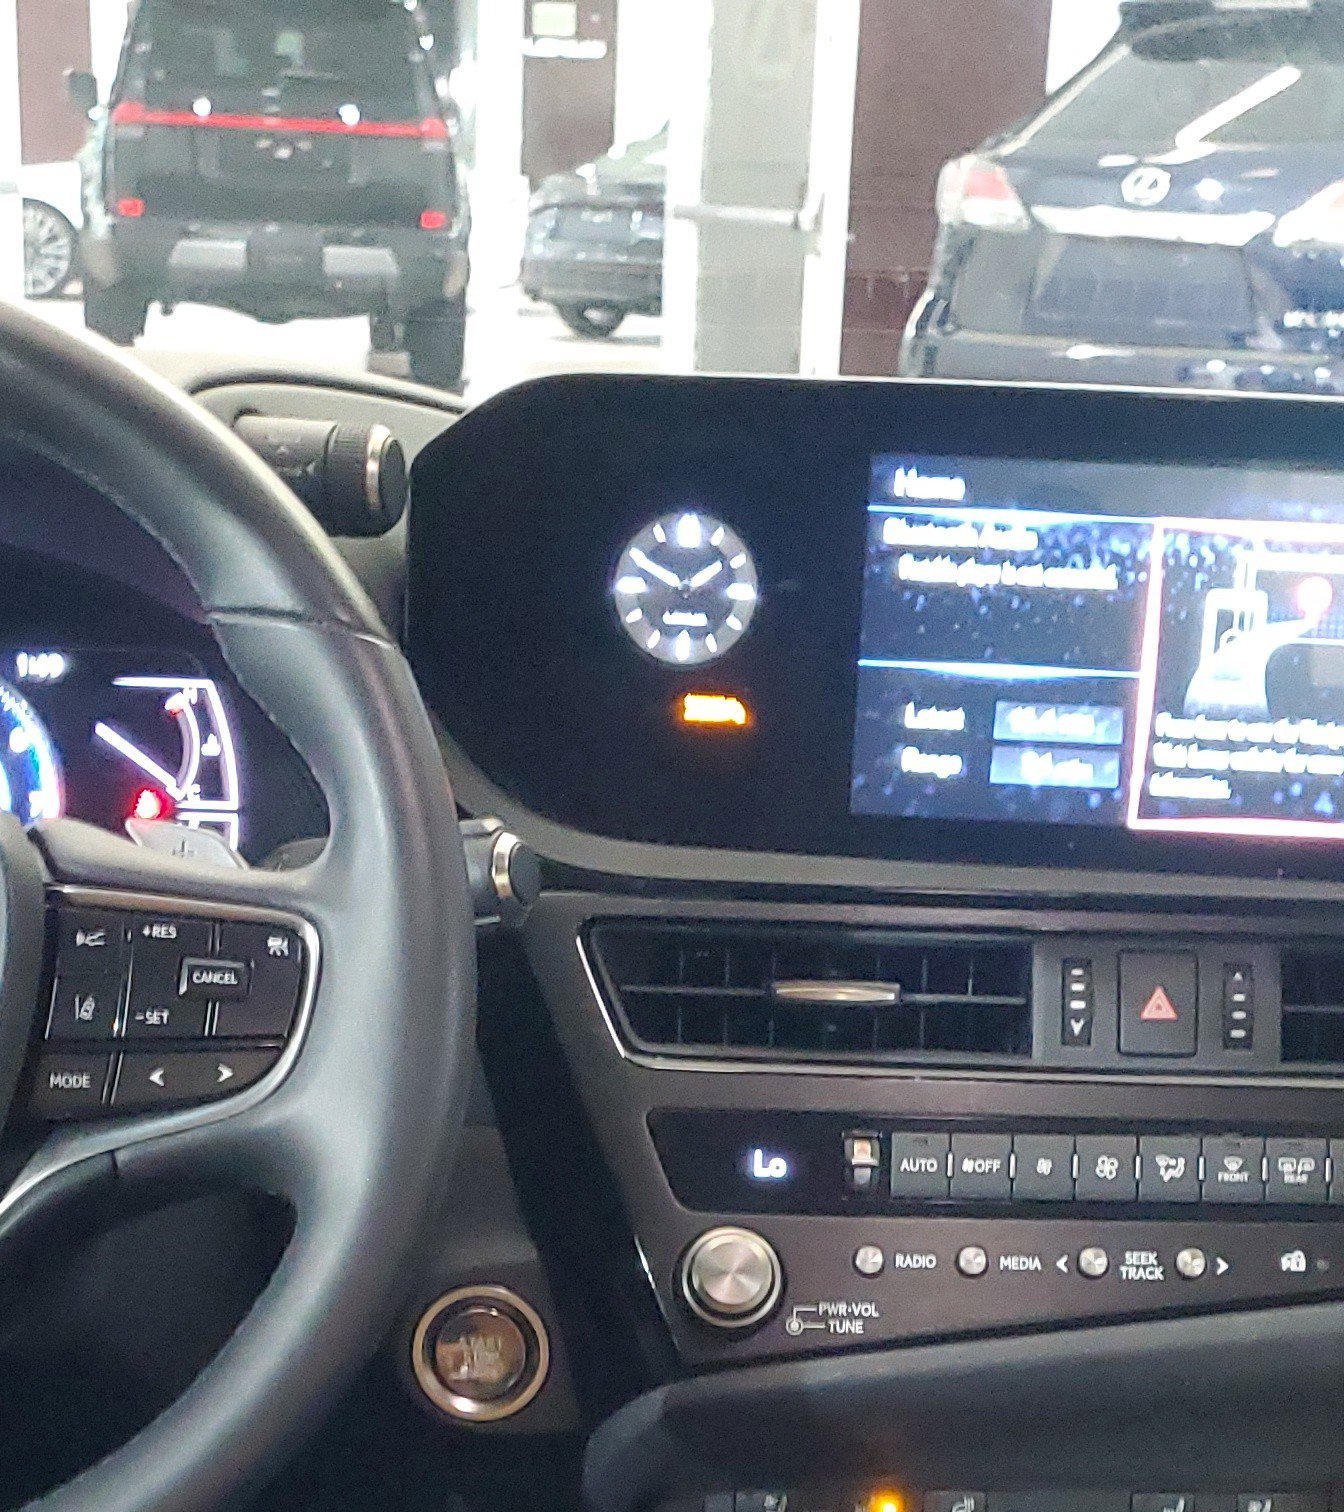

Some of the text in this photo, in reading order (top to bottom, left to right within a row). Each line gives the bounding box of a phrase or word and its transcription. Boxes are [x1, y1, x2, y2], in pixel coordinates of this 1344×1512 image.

[49, 1073, 91, 1089] MODE
[899, 1157, 938, 1173] AUTO
[975, 1157, 1001, 1173] OFF
[894, 1253, 937, 1270] RADIO
[999, 1255, 1042, 1271] MEDIA
[1124, 1251, 1159, 1266] SEEK
[1120, 1264, 1165, 1281] TRACK
[827, 1318, 865, 1335] TUNE
